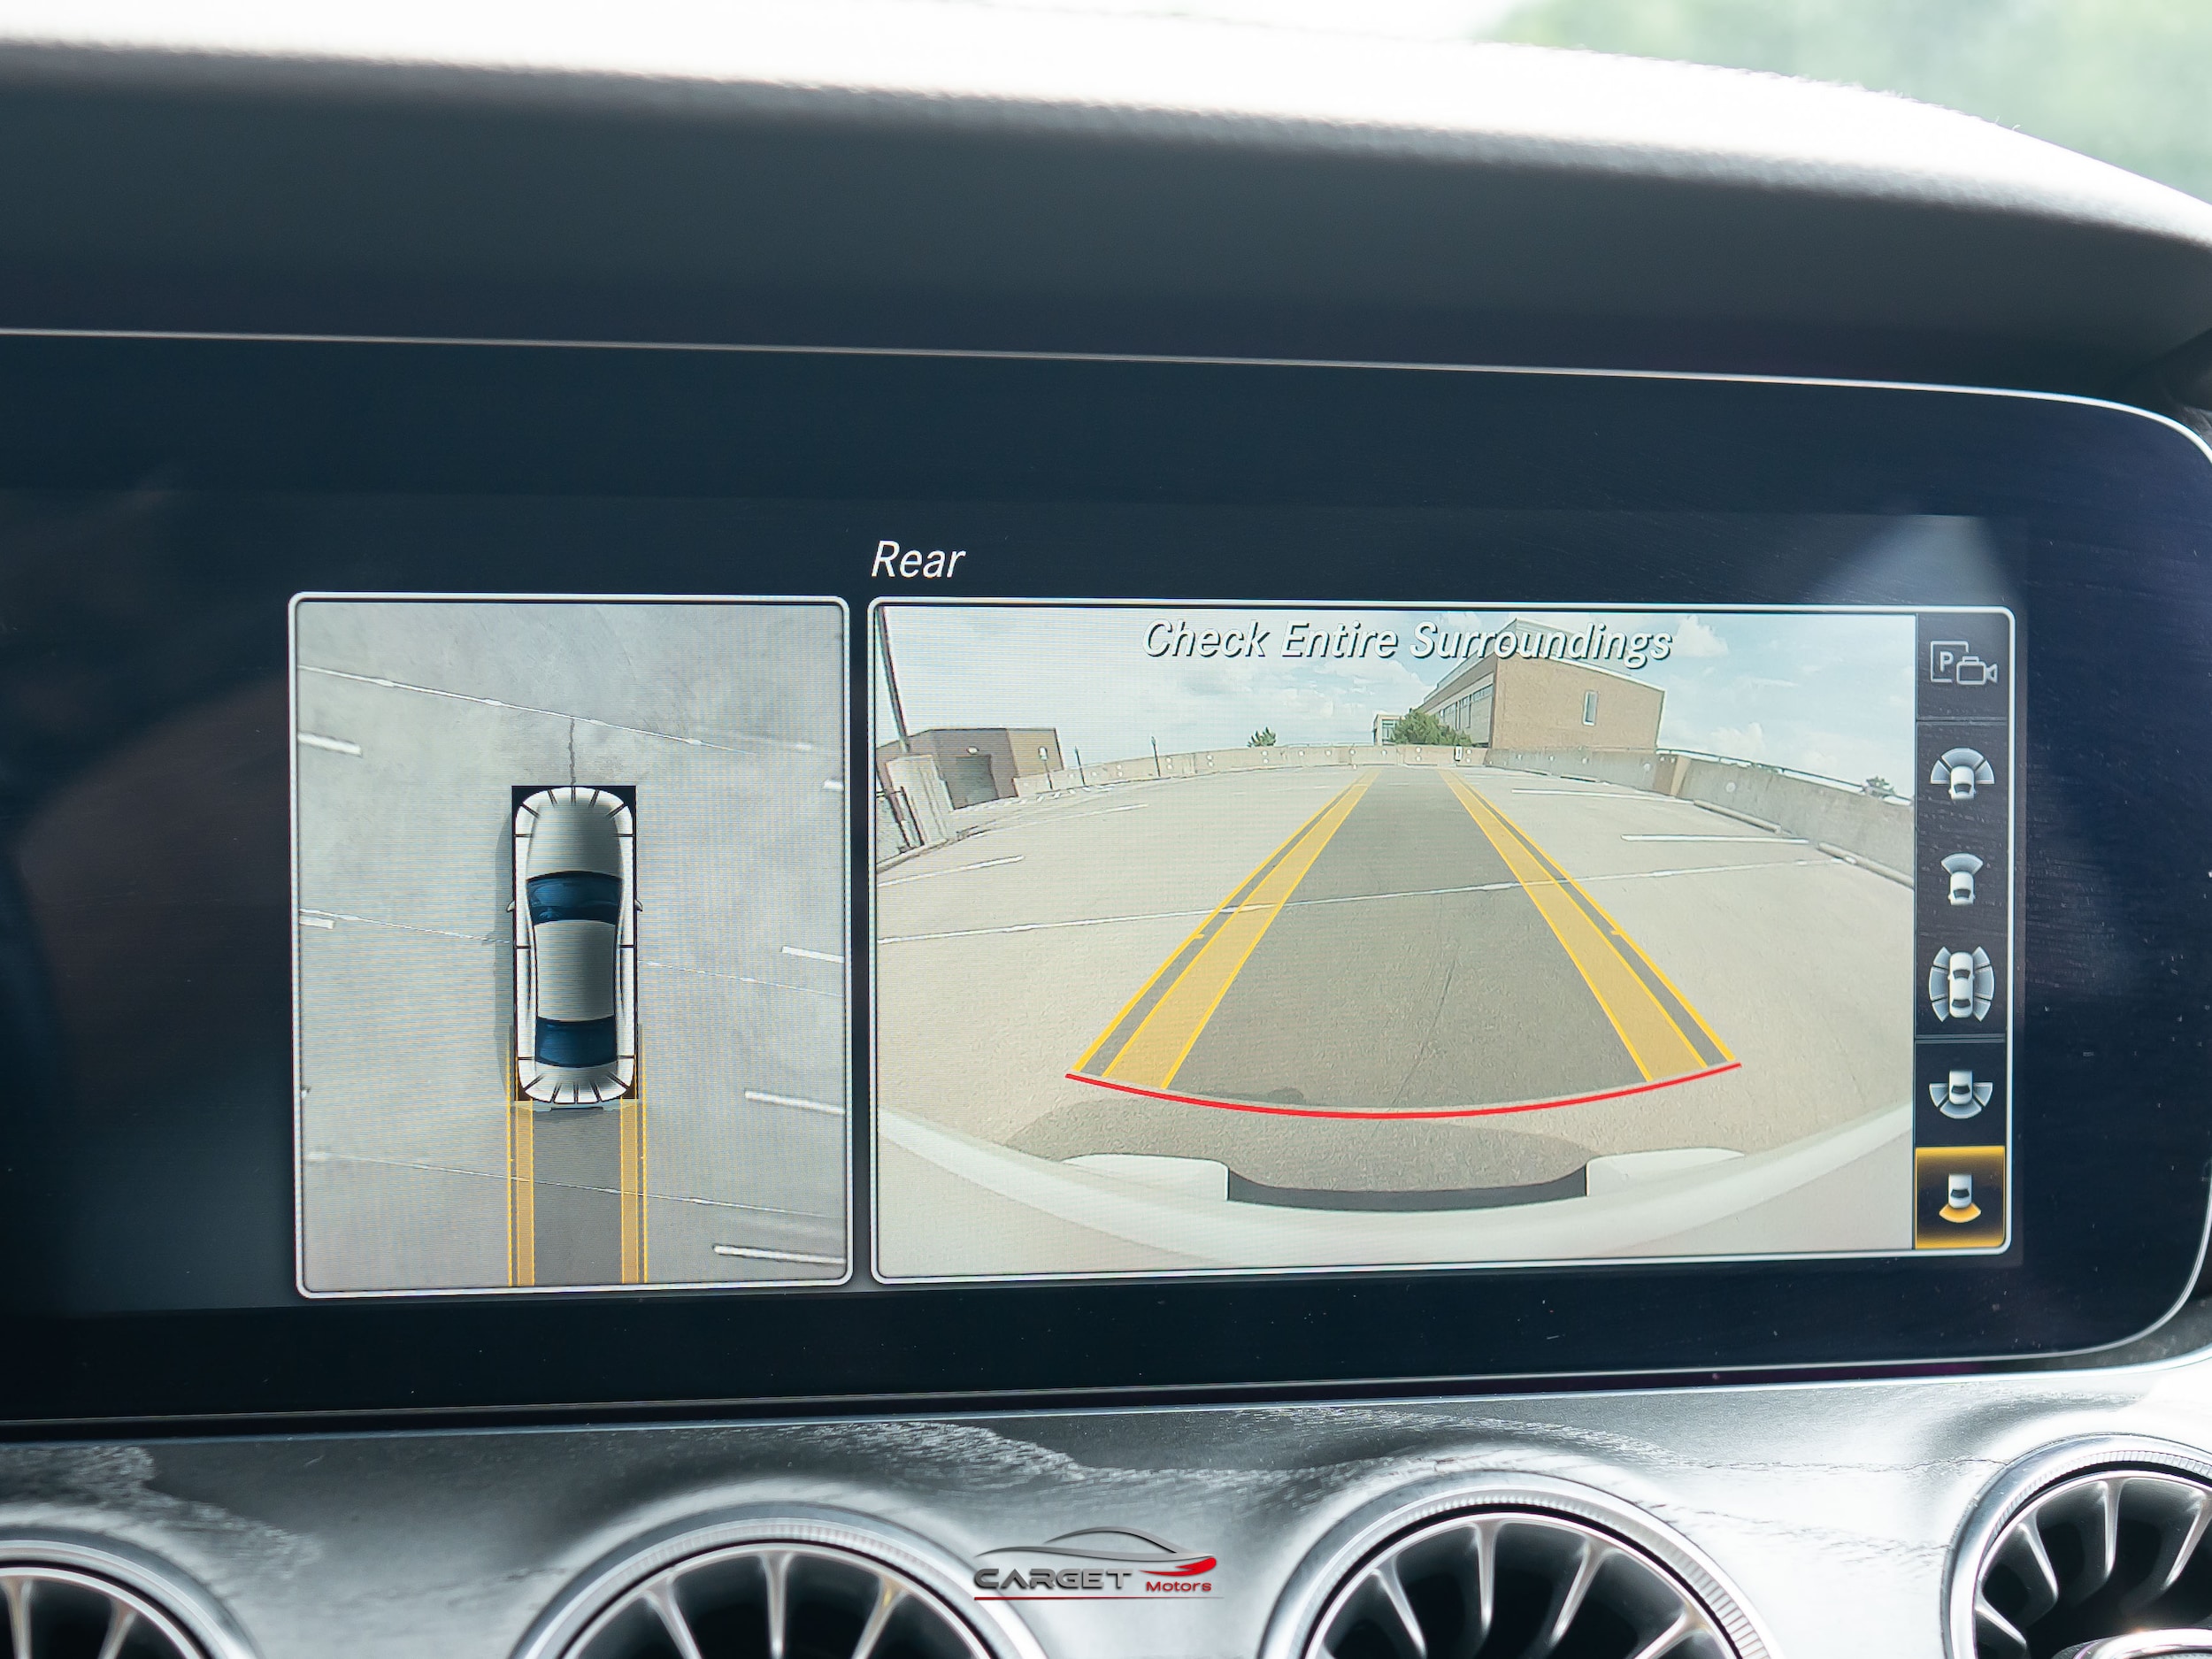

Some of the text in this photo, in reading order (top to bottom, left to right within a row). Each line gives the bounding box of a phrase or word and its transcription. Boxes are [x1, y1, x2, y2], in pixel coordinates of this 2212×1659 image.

[871, 541, 966, 579] Rear
[1143, 619, 1673, 669] Check Entire Surroundings
[1939, 650, 1954, 672] P
